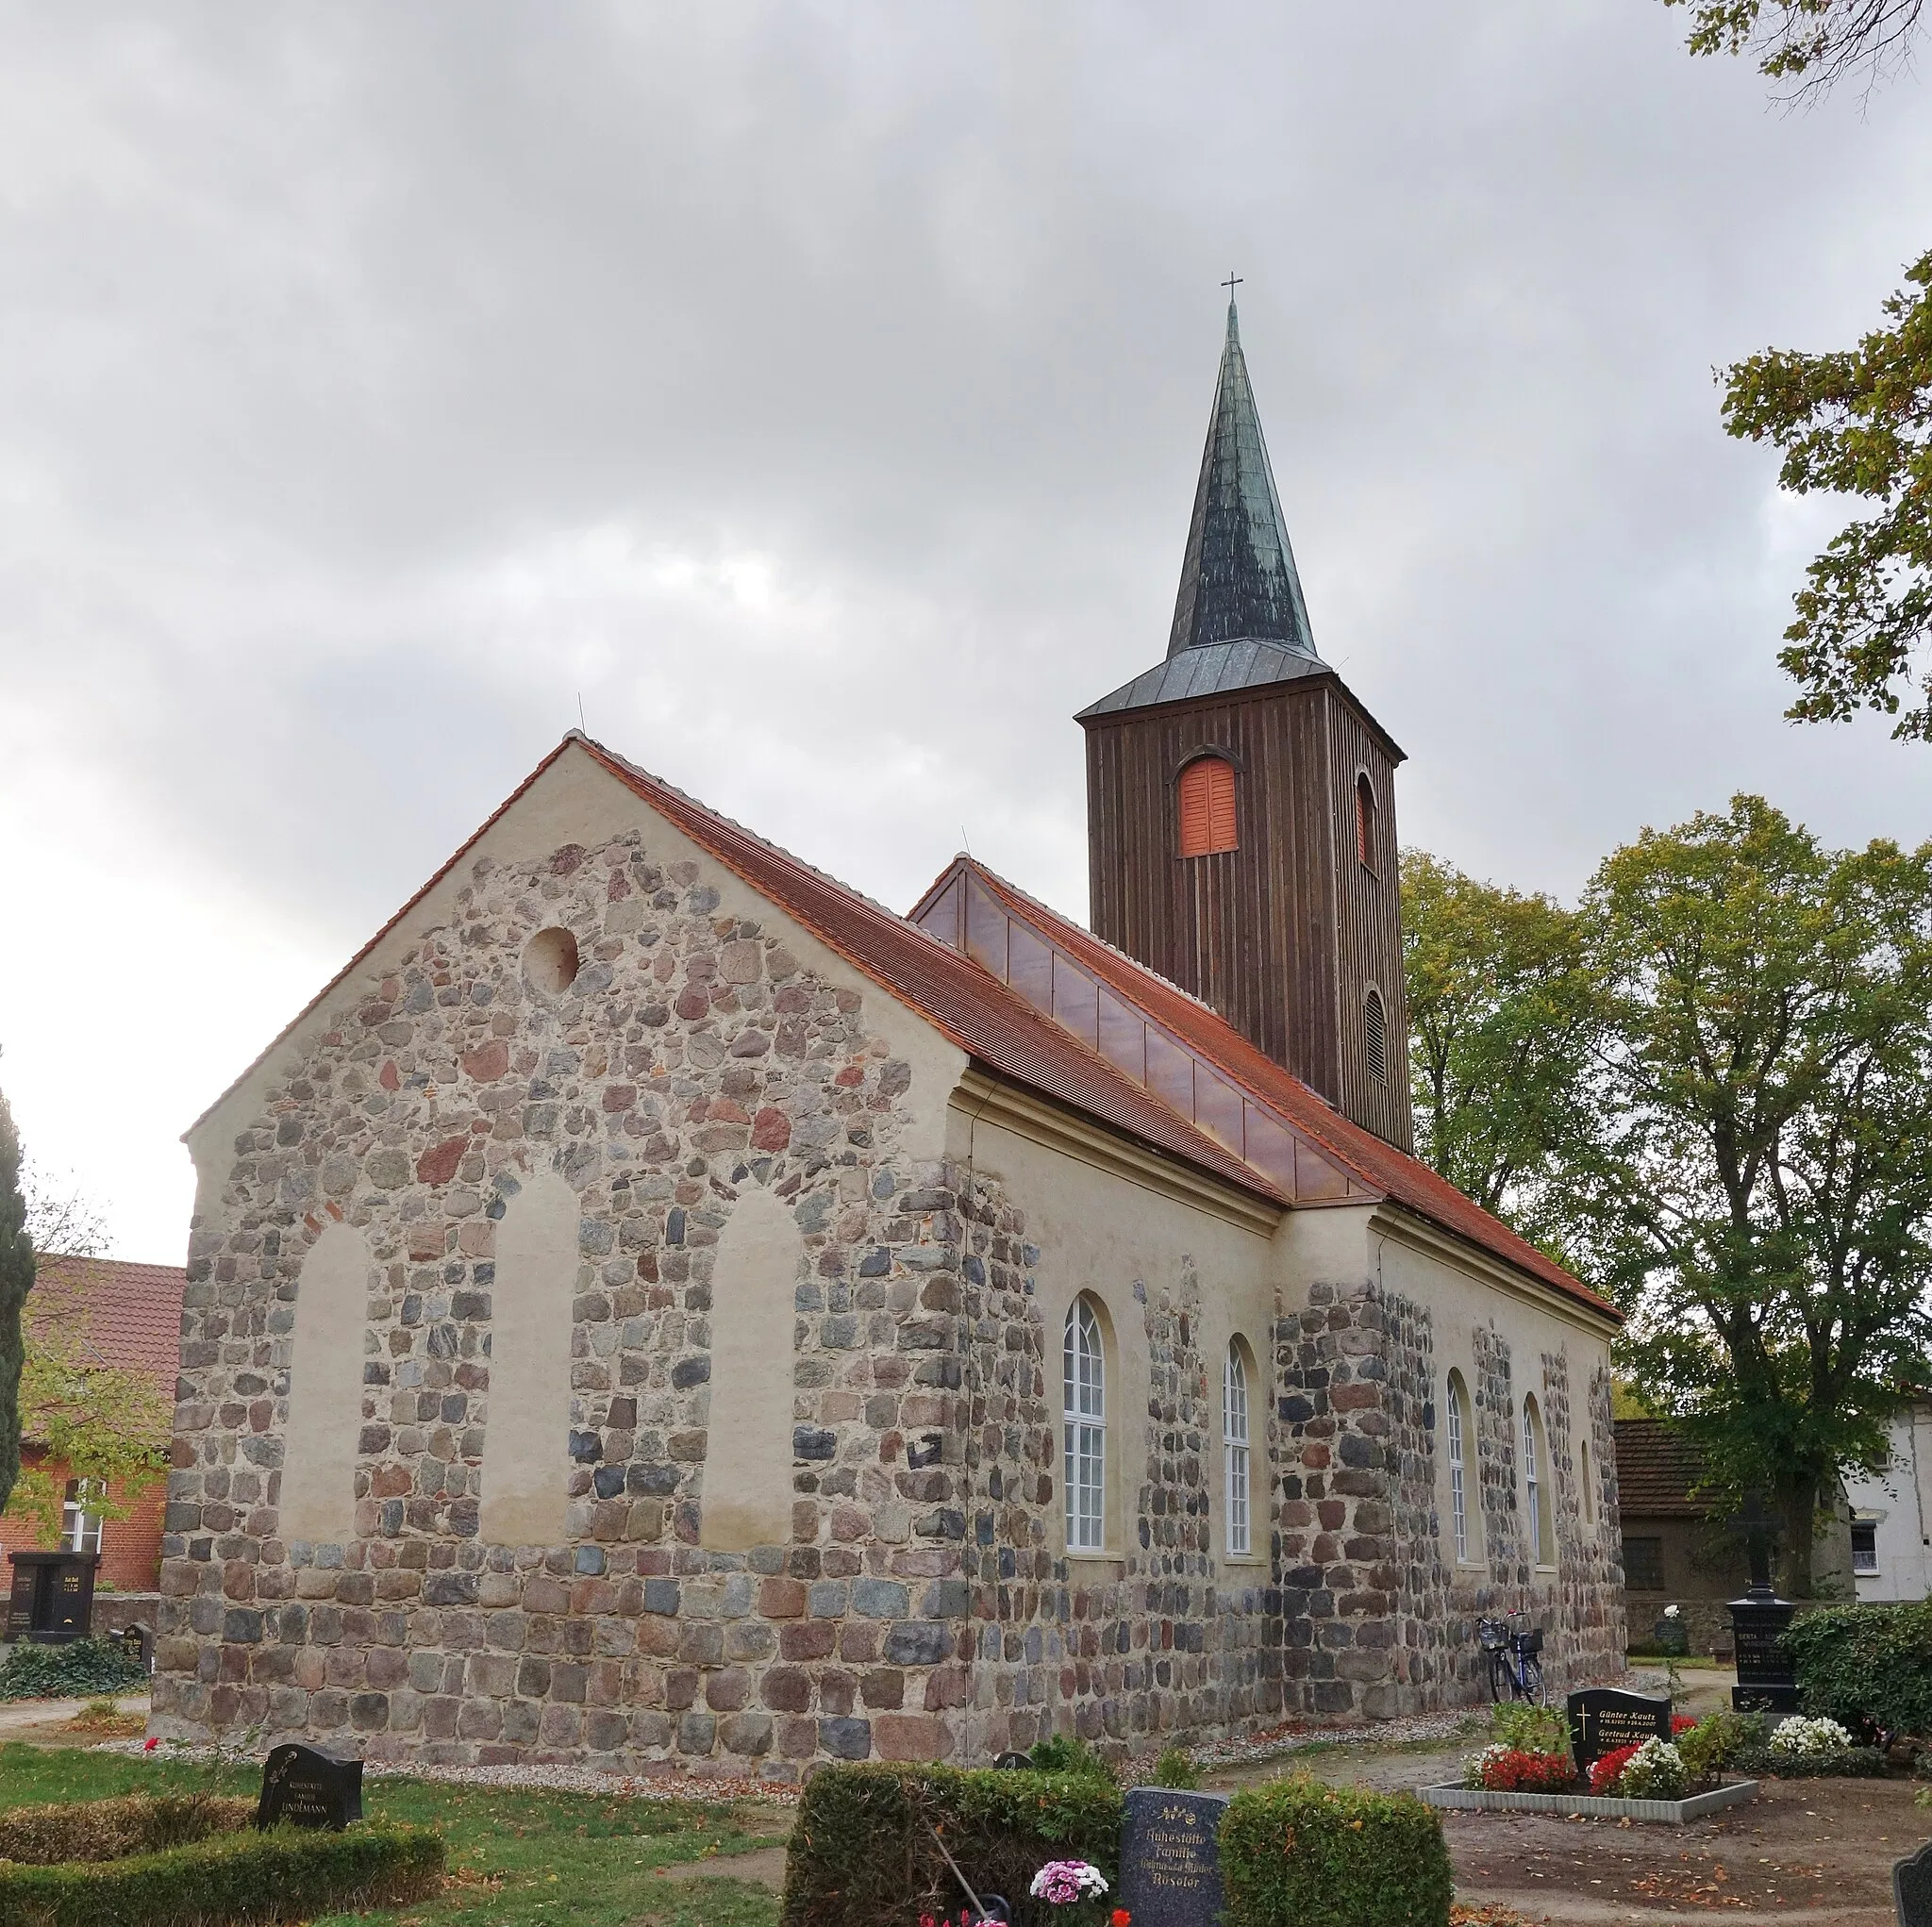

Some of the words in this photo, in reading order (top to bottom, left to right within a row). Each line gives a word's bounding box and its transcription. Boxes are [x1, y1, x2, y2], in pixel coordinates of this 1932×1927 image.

[1599, 1710, 1627, 1719] Günter
[1598, 1730, 1630, 1738] Gertrud
[282, 1802, 327, 1815] LINDEMANN
[1146, 1830, 1207, 1844] Ruhestätte
[1156, 1845, 1196, 1858] Familie
[1152, 1872, 1201, 1887] Röseler
